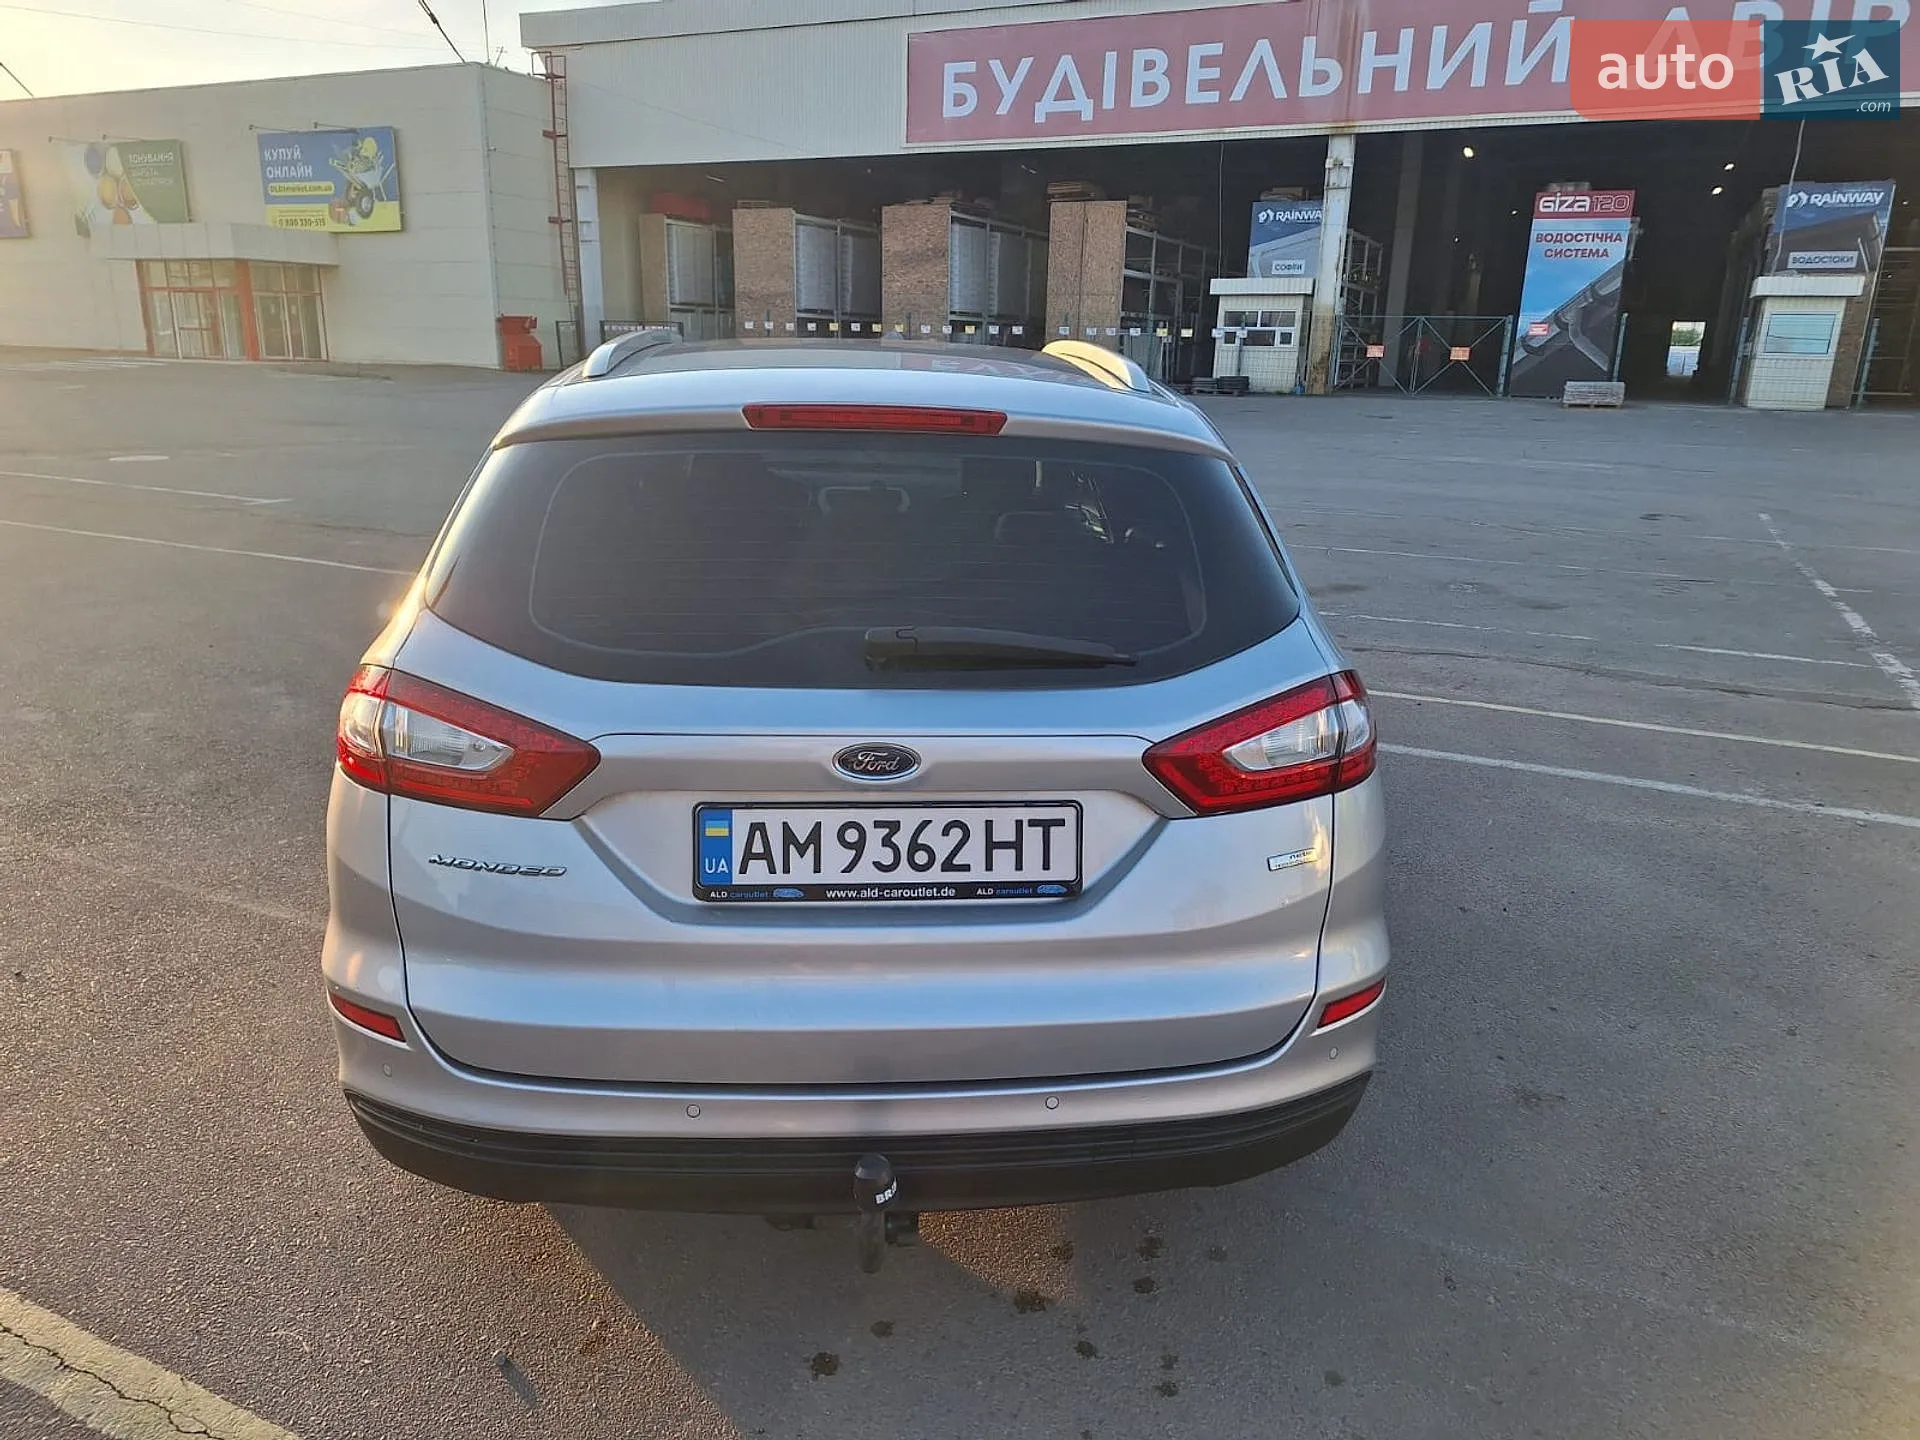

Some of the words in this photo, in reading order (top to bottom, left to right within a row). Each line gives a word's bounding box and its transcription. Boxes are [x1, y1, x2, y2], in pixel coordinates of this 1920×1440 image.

[942, 0, 1575, 124] БУДІВЕЛЬНИЙ
[264, 144, 302, 161] КУПУЙ
[266, 163, 313, 179] ОНЛАЙН
[1593, 194, 1630, 213] 120
[1810, 191, 1884, 206] RAINWAY
[1275, 209, 1322, 222] RAINWA
[1536, 232, 1623, 244] ВОДОСТІЧНА
[1544, 248, 1610, 258] СИСТЕМА
[853, 751, 900, 771] Ford
[738, 821, 823, 875] AM
[836, 819, 971, 874] 9362
[984, 818, 1066, 872] HT
[428, 854, 567, 877] MONDEO
[704, 858, 729, 874] UA
[826, 886, 956, 899] www.ald-caroutlet.de
[976, 887, 994, 895] ALD
[875, 1177, 897, 1204] BR
